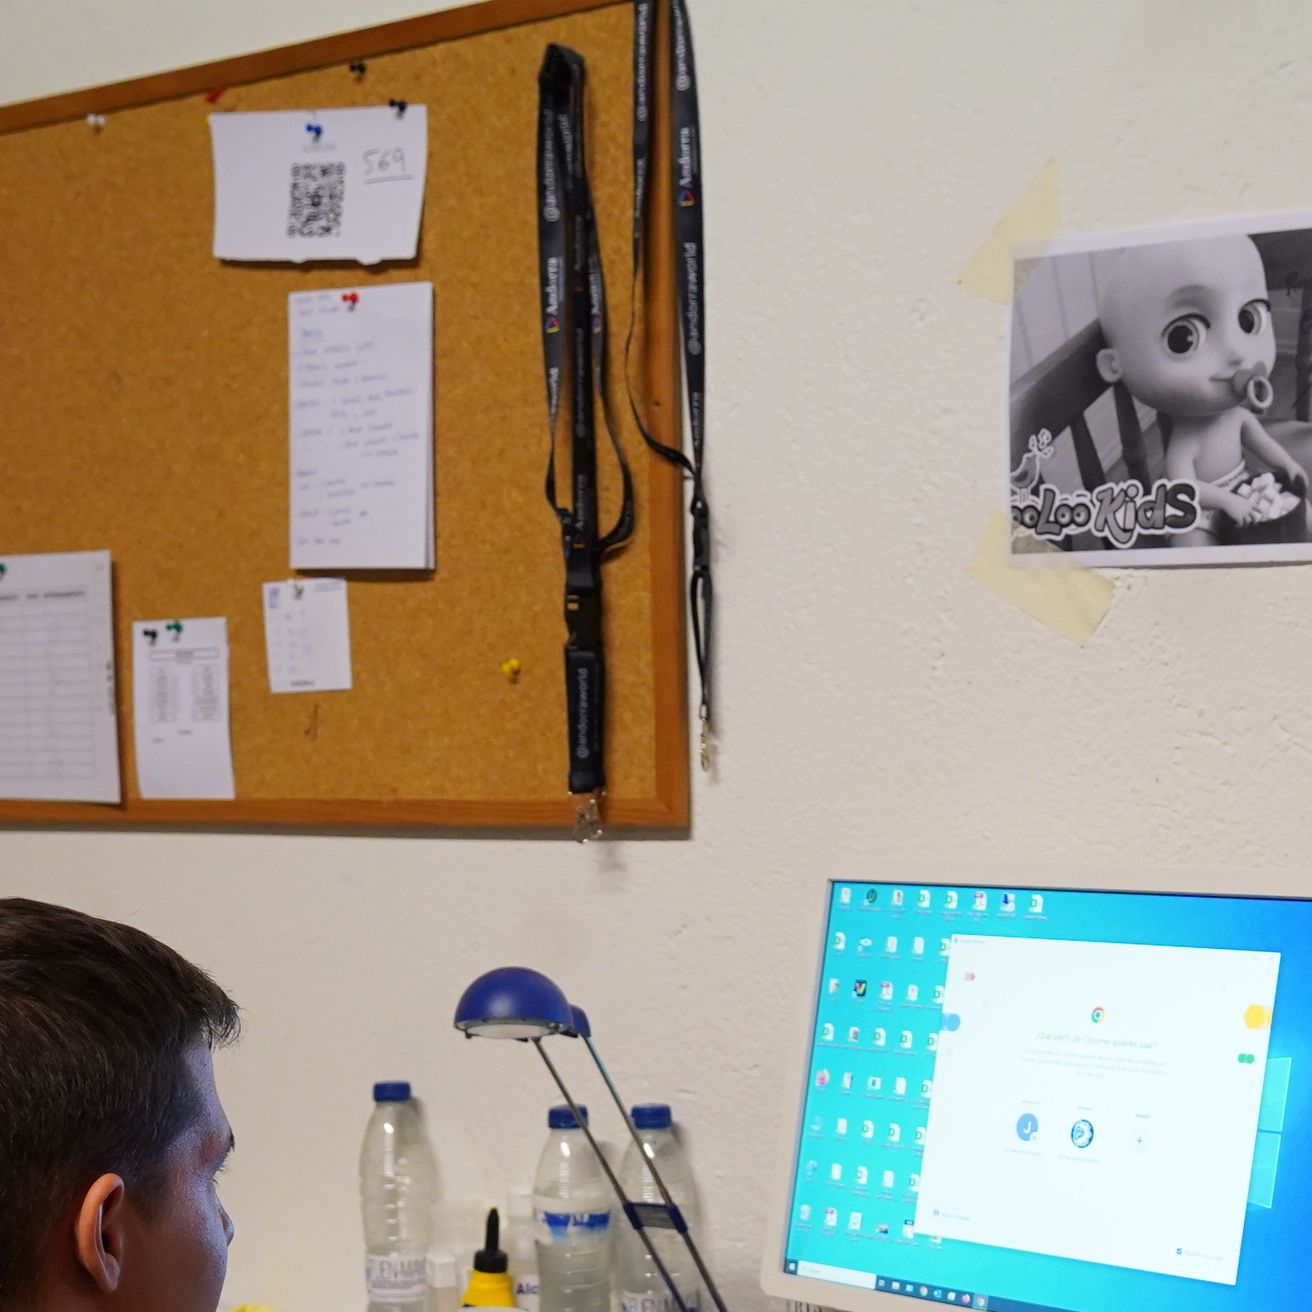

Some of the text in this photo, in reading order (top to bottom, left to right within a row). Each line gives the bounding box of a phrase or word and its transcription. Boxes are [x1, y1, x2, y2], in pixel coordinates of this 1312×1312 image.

[362, 145, 406, 175] 569
[679, 127, 689, 188] Andorra
[546, 257, 558, 315] Andorra
[684, 242, 701, 355] @andorraworld
[577, 667, 589, 759] @andorraworld
